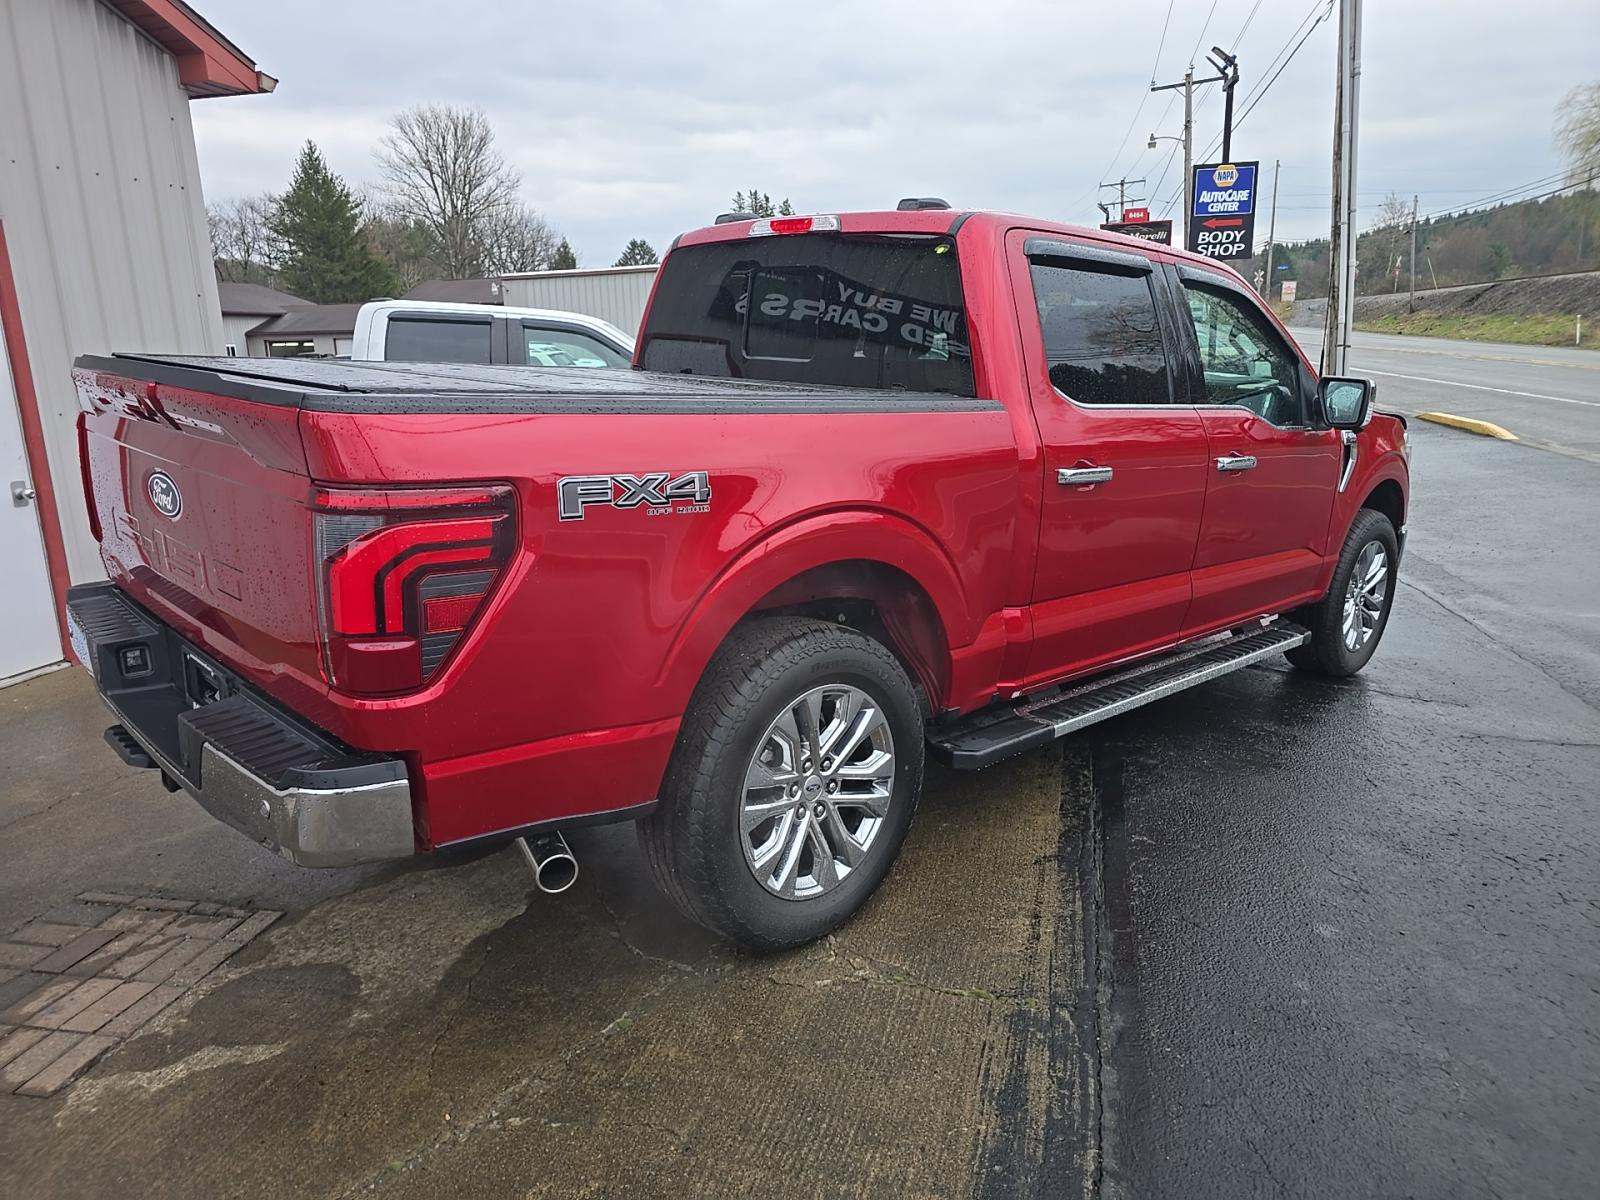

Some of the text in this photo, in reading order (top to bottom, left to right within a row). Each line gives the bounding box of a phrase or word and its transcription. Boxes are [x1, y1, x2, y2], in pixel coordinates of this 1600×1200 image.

[1217, 171, 1235, 181] NAPA
[1208, 202, 1239, 212] CENTER
[1197, 230, 1246, 244] BODY
[1197, 243, 1246, 257] SHOP
[557, 471, 711, 521] FX4
